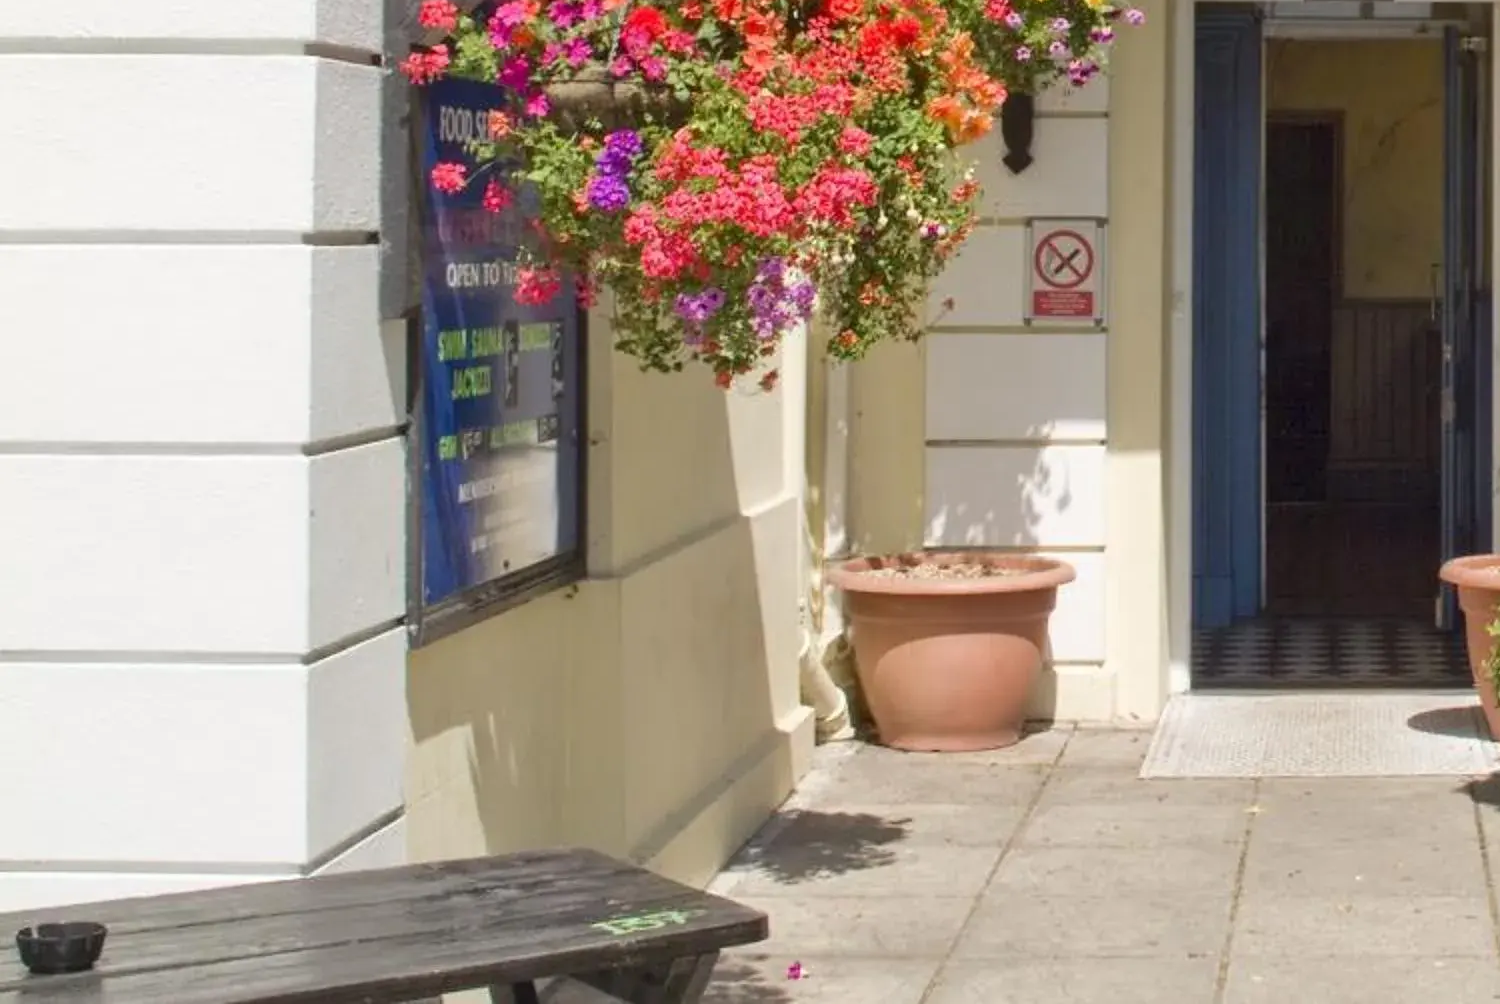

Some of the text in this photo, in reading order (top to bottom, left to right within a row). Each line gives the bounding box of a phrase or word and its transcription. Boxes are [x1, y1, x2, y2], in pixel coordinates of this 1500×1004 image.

[439, 105, 473, 143] FOOD
[446, 261, 479, 288] OPEN
[482, 262, 500, 285] TO
